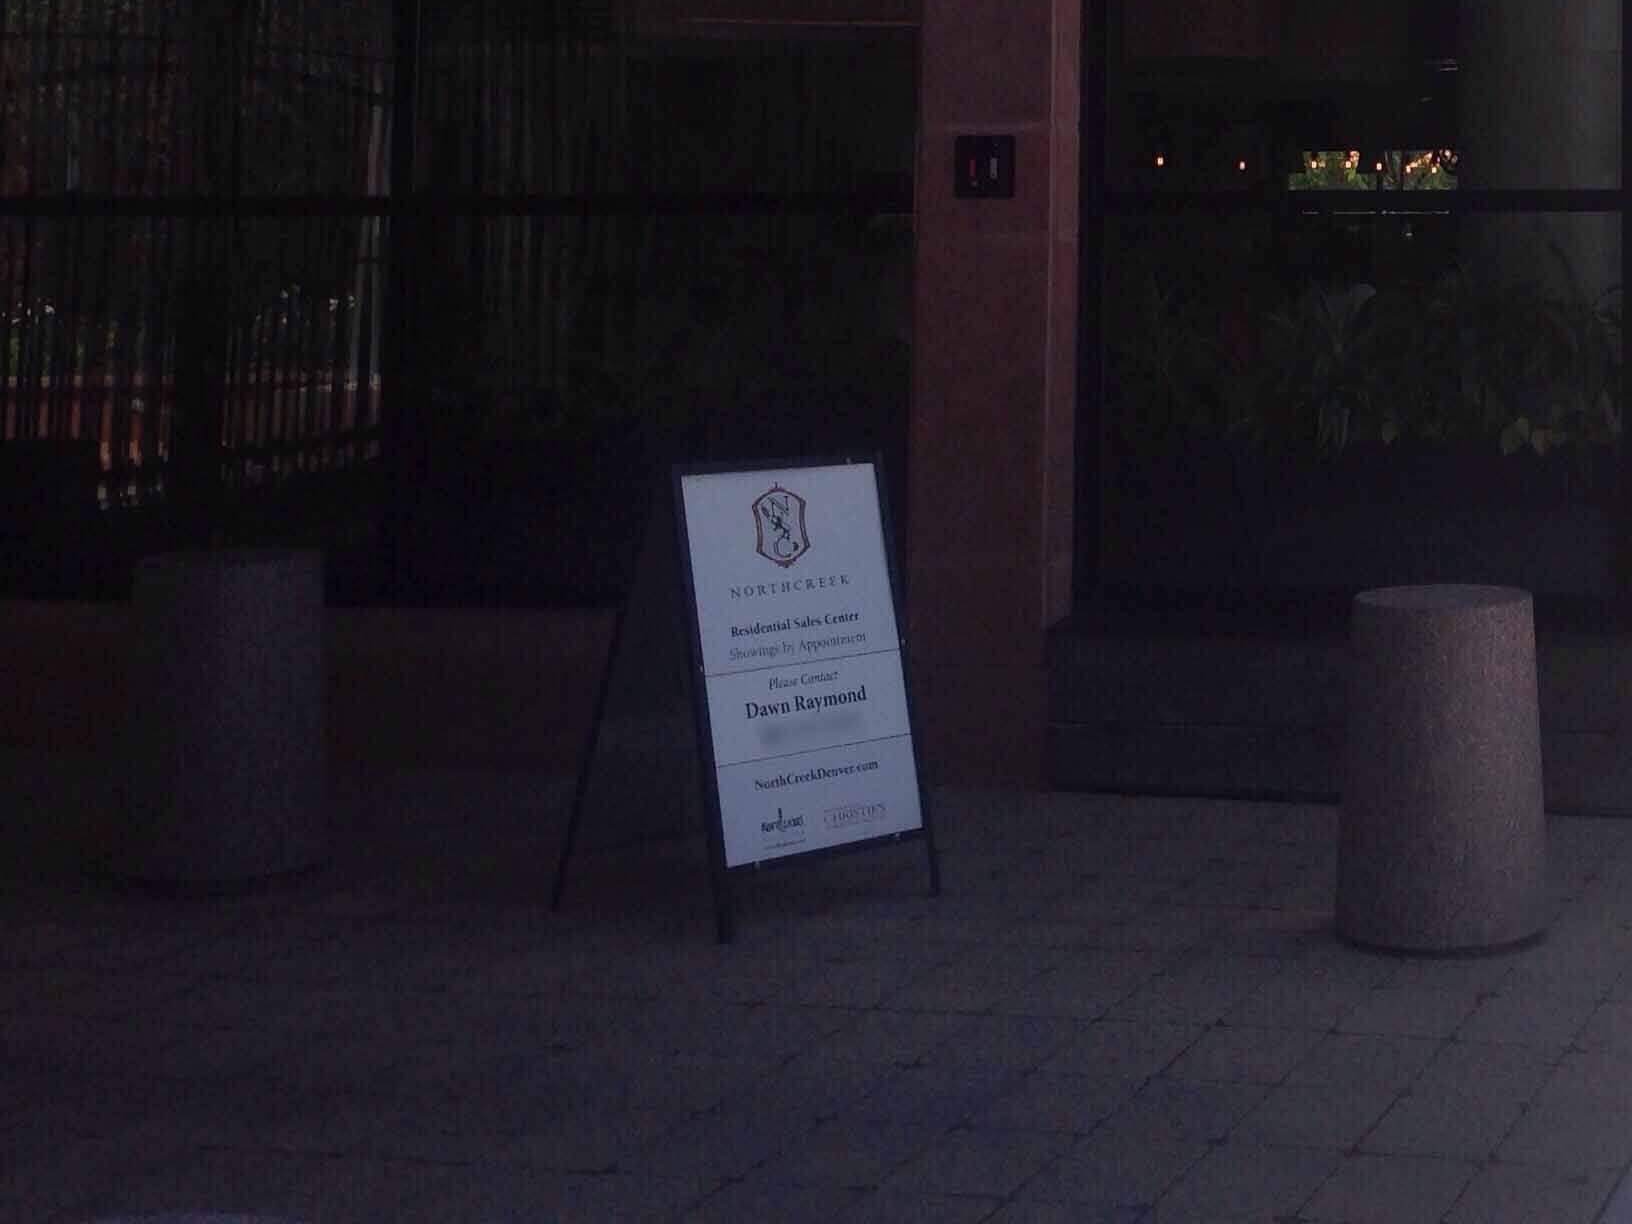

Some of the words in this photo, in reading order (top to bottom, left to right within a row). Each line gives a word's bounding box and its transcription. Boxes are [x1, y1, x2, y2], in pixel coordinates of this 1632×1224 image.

[730, 575, 850, 599] NORTHCREEK
[731, 619, 790, 637] Residential
[795, 615, 822, 628] Sales
[825, 612, 859, 624] Center
[729, 642, 779, 660] Showings
[783, 640, 795, 654] by
[799, 633, 867, 652] Appointment
[769, 677, 798, 690] Please
[801, 671, 839, 685] Contact
[745, 700, 791, 719] Dawn
[795, 685, 867, 712] Raymond
[755, 760, 879, 791] NorthCreekDenver.com
